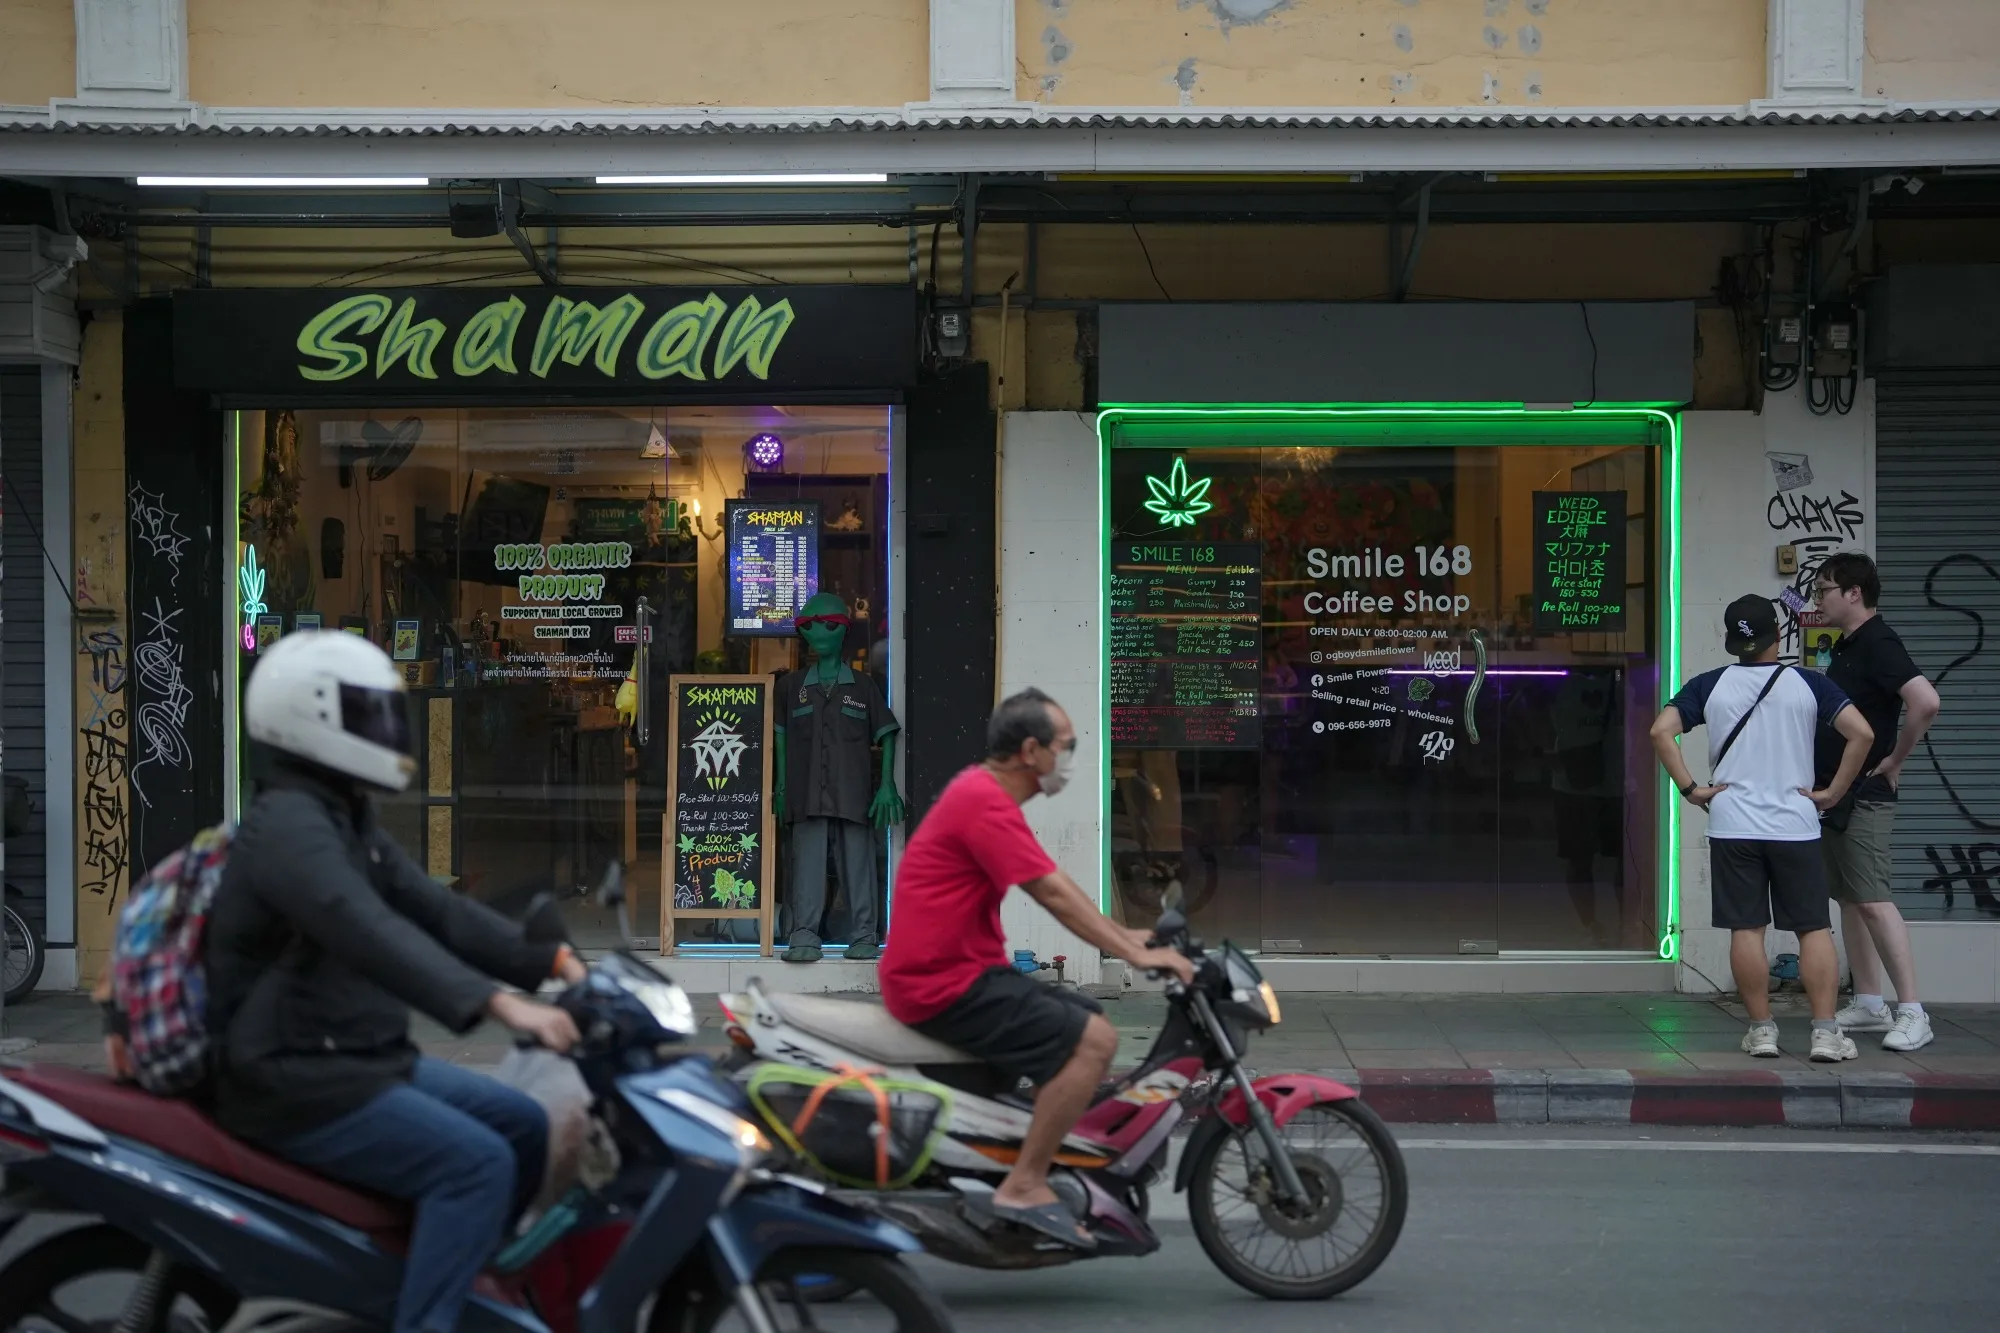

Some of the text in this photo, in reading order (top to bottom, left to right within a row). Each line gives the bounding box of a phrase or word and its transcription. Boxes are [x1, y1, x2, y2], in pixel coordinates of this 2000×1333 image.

[297, 292, 795, 381] Shaman
[1559, 497, 1599, 509] WEED
[747, 511, 803, 526] SHAMAN
[1547, 510, 1607, 525] EDIBLE
[1559, 524, 1588, 538] 大麻
[1131, 546, 1215, 562] SMILE 168
[1545, 542, 1611, 557] マリファナ
[494, 542, 632, 570] 100% ORGANIC
[1306, 545, 1472, 578] Smile 168
[1165, 565, 1198, 574] MENU
[1225, 565, 1255, 575] Edible
[1548, 559, 1605, 577] 대마초
[519, 574, 605, 601] PRODUCT
[1552, 577, 1602, 588] Price start
[1110, 588, 1136, 597] other
[1303, 590, 1470, 616] Coffee Shop
[1541, 601, 1620, 613] Pre Roll 100-200
[502, 606, 623, 618] SUPPORT THAI LOCAL GROWER
[1562, 613, 1600, 625] HASH
[1801, 613, 1825, 624] MIS
[535, 626, 590, 638] SHAMAN BKK
[1310, 627, 1338, 636] OPEN
[1342, 628, 1371, 637] DAILY
[1374, 629, 1428, 638] 08:00-02:00
[1325, 646, 1416, 661] ogboydsmileflower
[1229, 661, 1257, 670] INDICA
[1327, 669, 1354, 684] Smile
[686, 686, 757, 706] SHAMAN
[1371, 685, 1390, 695] 4:20
[1229, 707, 1258, 717] HYBRID
[1311, 689, 1343, 704] Selling
[1346, 697, 1370, 708] retail
[1372, 701, 1397, 713] price
[1407, 708, 1454, 725] wholesale
[1328, 719, 1391, 731] 096-656-9978
[1418, 730, 1455, 764] 420
[678, 793, 696, 803] Price
[697, 793, 716, 802] Start
[678, 810, 707, 821] Pre-Roll
[681, 822, 749, 833] Thanks For Support
[705, 834, 732, 844] 100%
[695, 844, 739, 853] ORGANIC
[689, 852, 744, 871] Product
